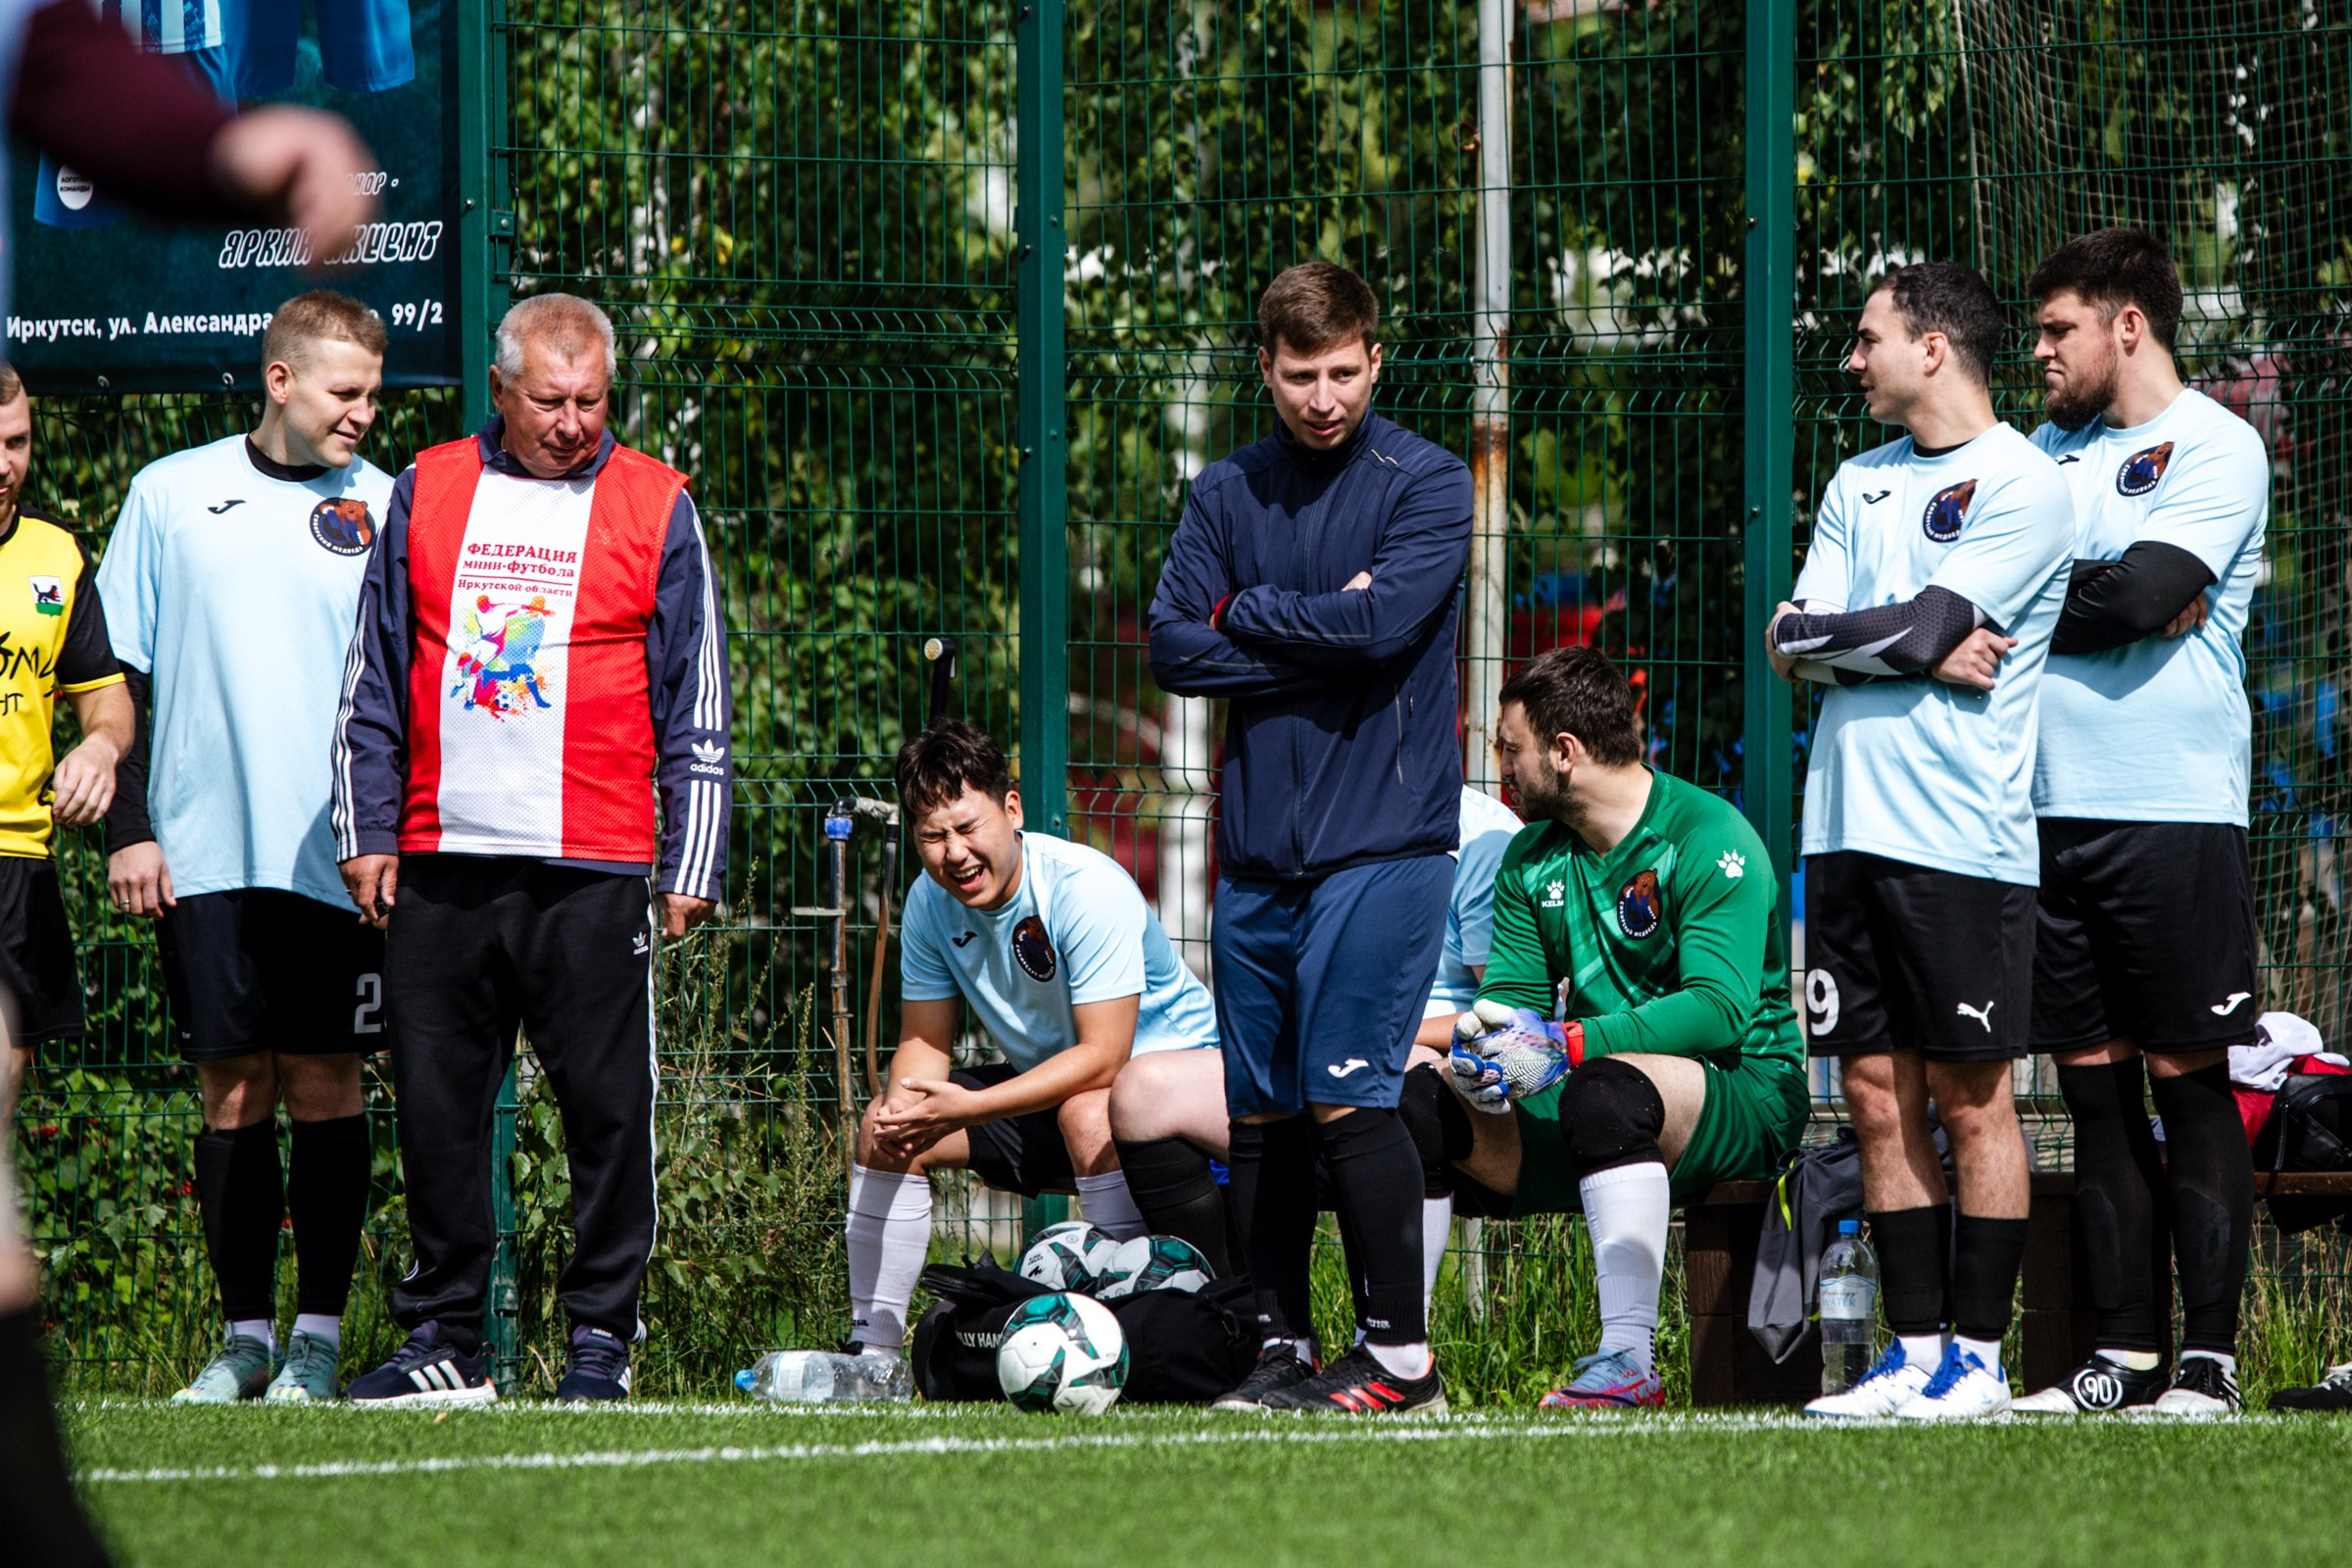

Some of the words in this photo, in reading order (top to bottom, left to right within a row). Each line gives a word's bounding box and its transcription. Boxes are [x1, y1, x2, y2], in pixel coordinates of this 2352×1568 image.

[323, 220, 443, 265] КЦЕНТ
[6, 316, 101, 343] Иркутск,
[108, 317, 137, 340] ул.
[143, 312, 273, 336] Александра
[392, 299, 443, 331] 99/2
[466, 543, 578, 564] ФЕДЕРАЦИЯ
[458, 579, 522, 592] Иркутской
[525, 583, 573, 598] области
[690, 762, 725, 776] adidas
[355, 973, 381, 1035] 2
[1805, 968, 1839, 1036] 9
[977, 1332, 1003, 1348] HAN
[2083, 1375, 2113, 1403] 90
